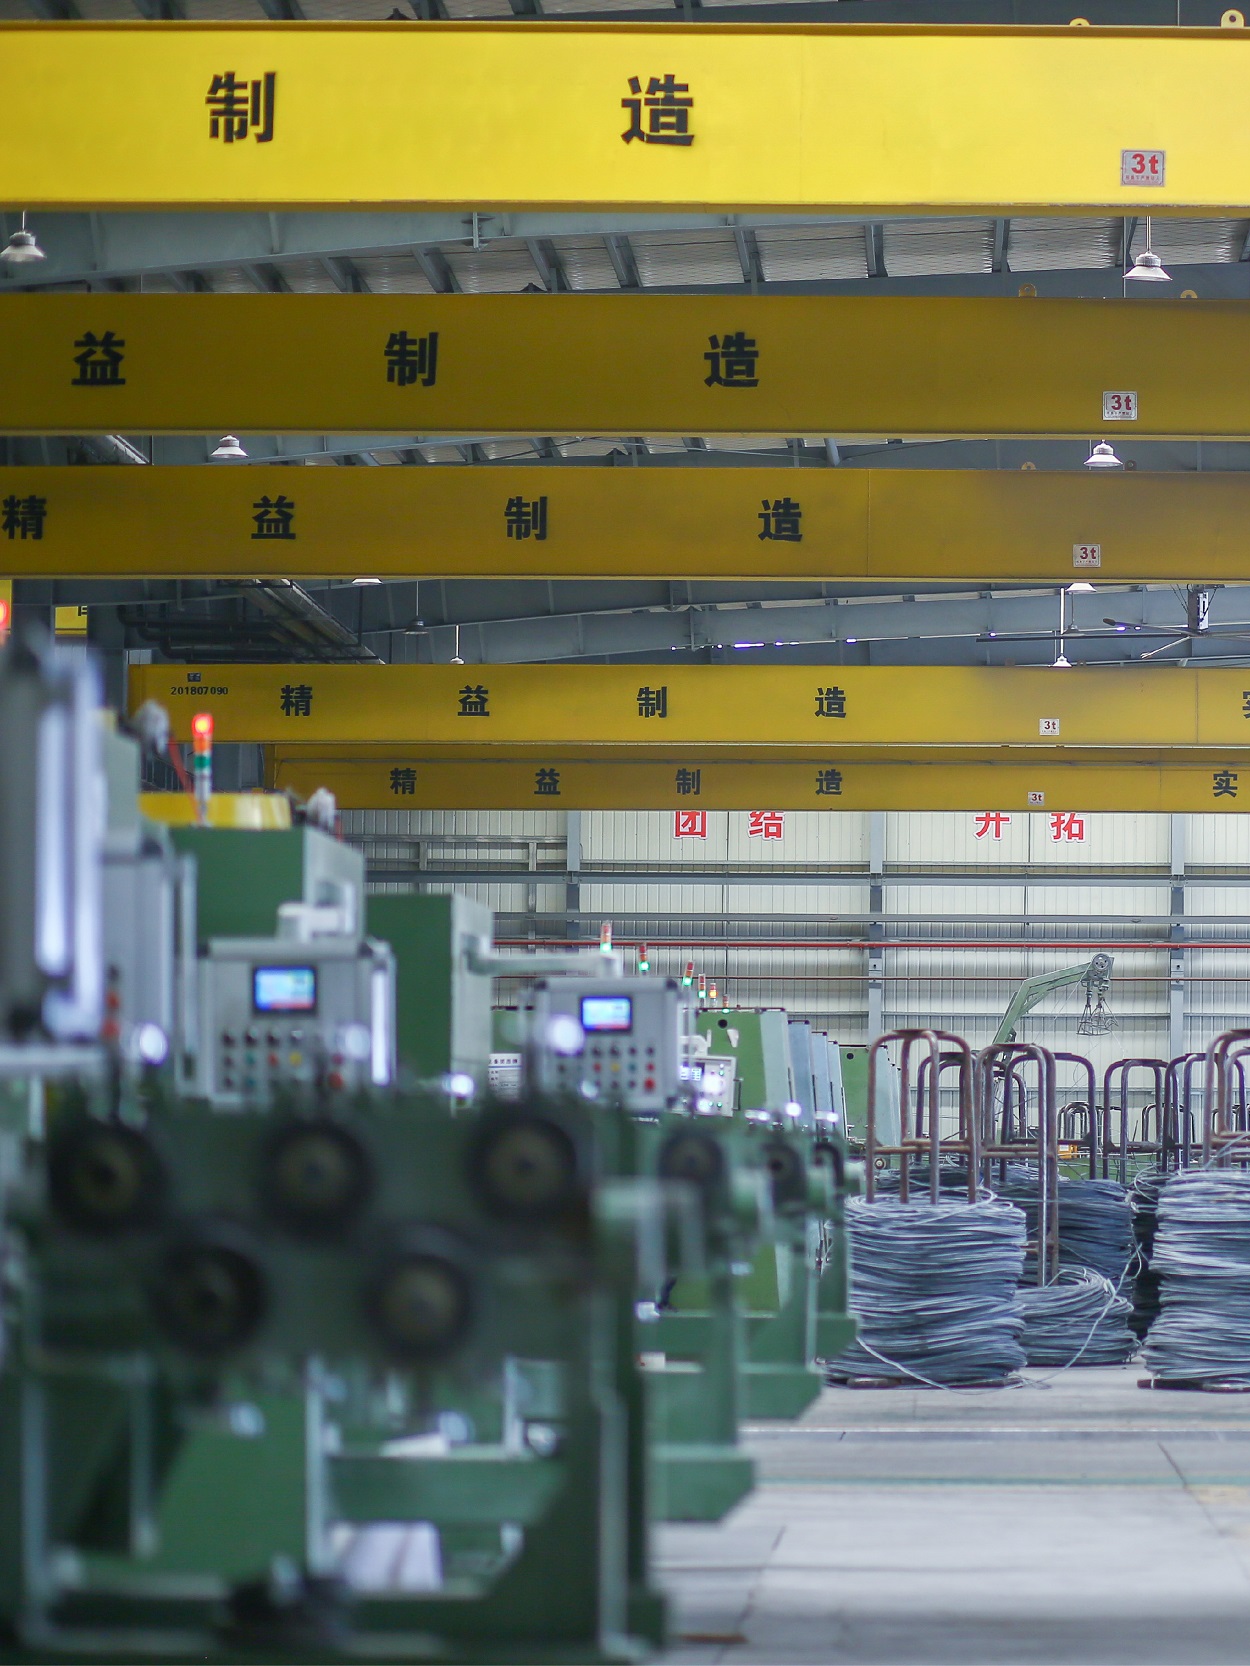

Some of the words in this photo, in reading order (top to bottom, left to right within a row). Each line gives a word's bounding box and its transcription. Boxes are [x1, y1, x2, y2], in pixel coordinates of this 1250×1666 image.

[1131, 153, 1159, 175] 3t
[1111, 394, 1132, 411] 3t
[1080, 546, 1097, 560] 3t
[1044, 720, 1057, 731] 3t
[1031, 793, 1043, 802] 3t
